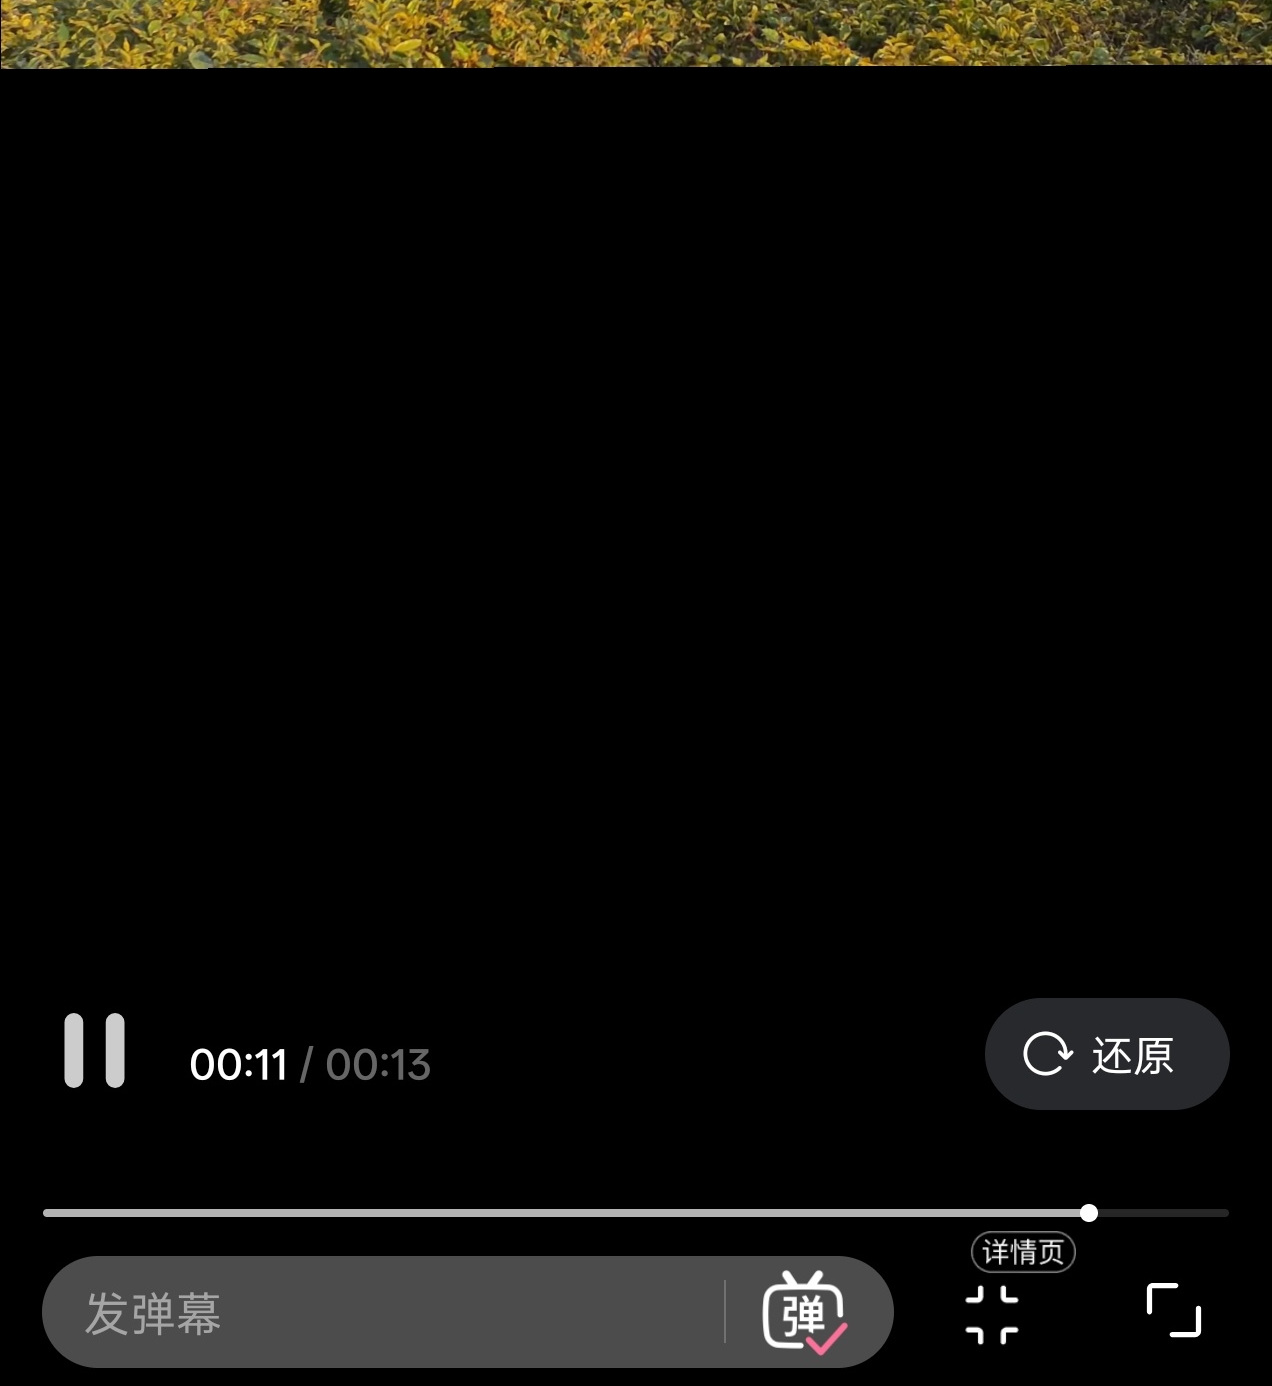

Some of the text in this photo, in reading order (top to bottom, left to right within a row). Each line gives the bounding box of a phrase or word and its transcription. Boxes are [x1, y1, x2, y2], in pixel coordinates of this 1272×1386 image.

[191, 1048, 288, 1081] 00:11
[326, 1048, 430, 1081] 00:13
[1092, 1036, 1174, 1076] 还原
[982, 1239, 1064, 1265] 详情页
[85, 1291, 221, 1336] 发弹幕
[783, 1294, 825, 1337] 弹
